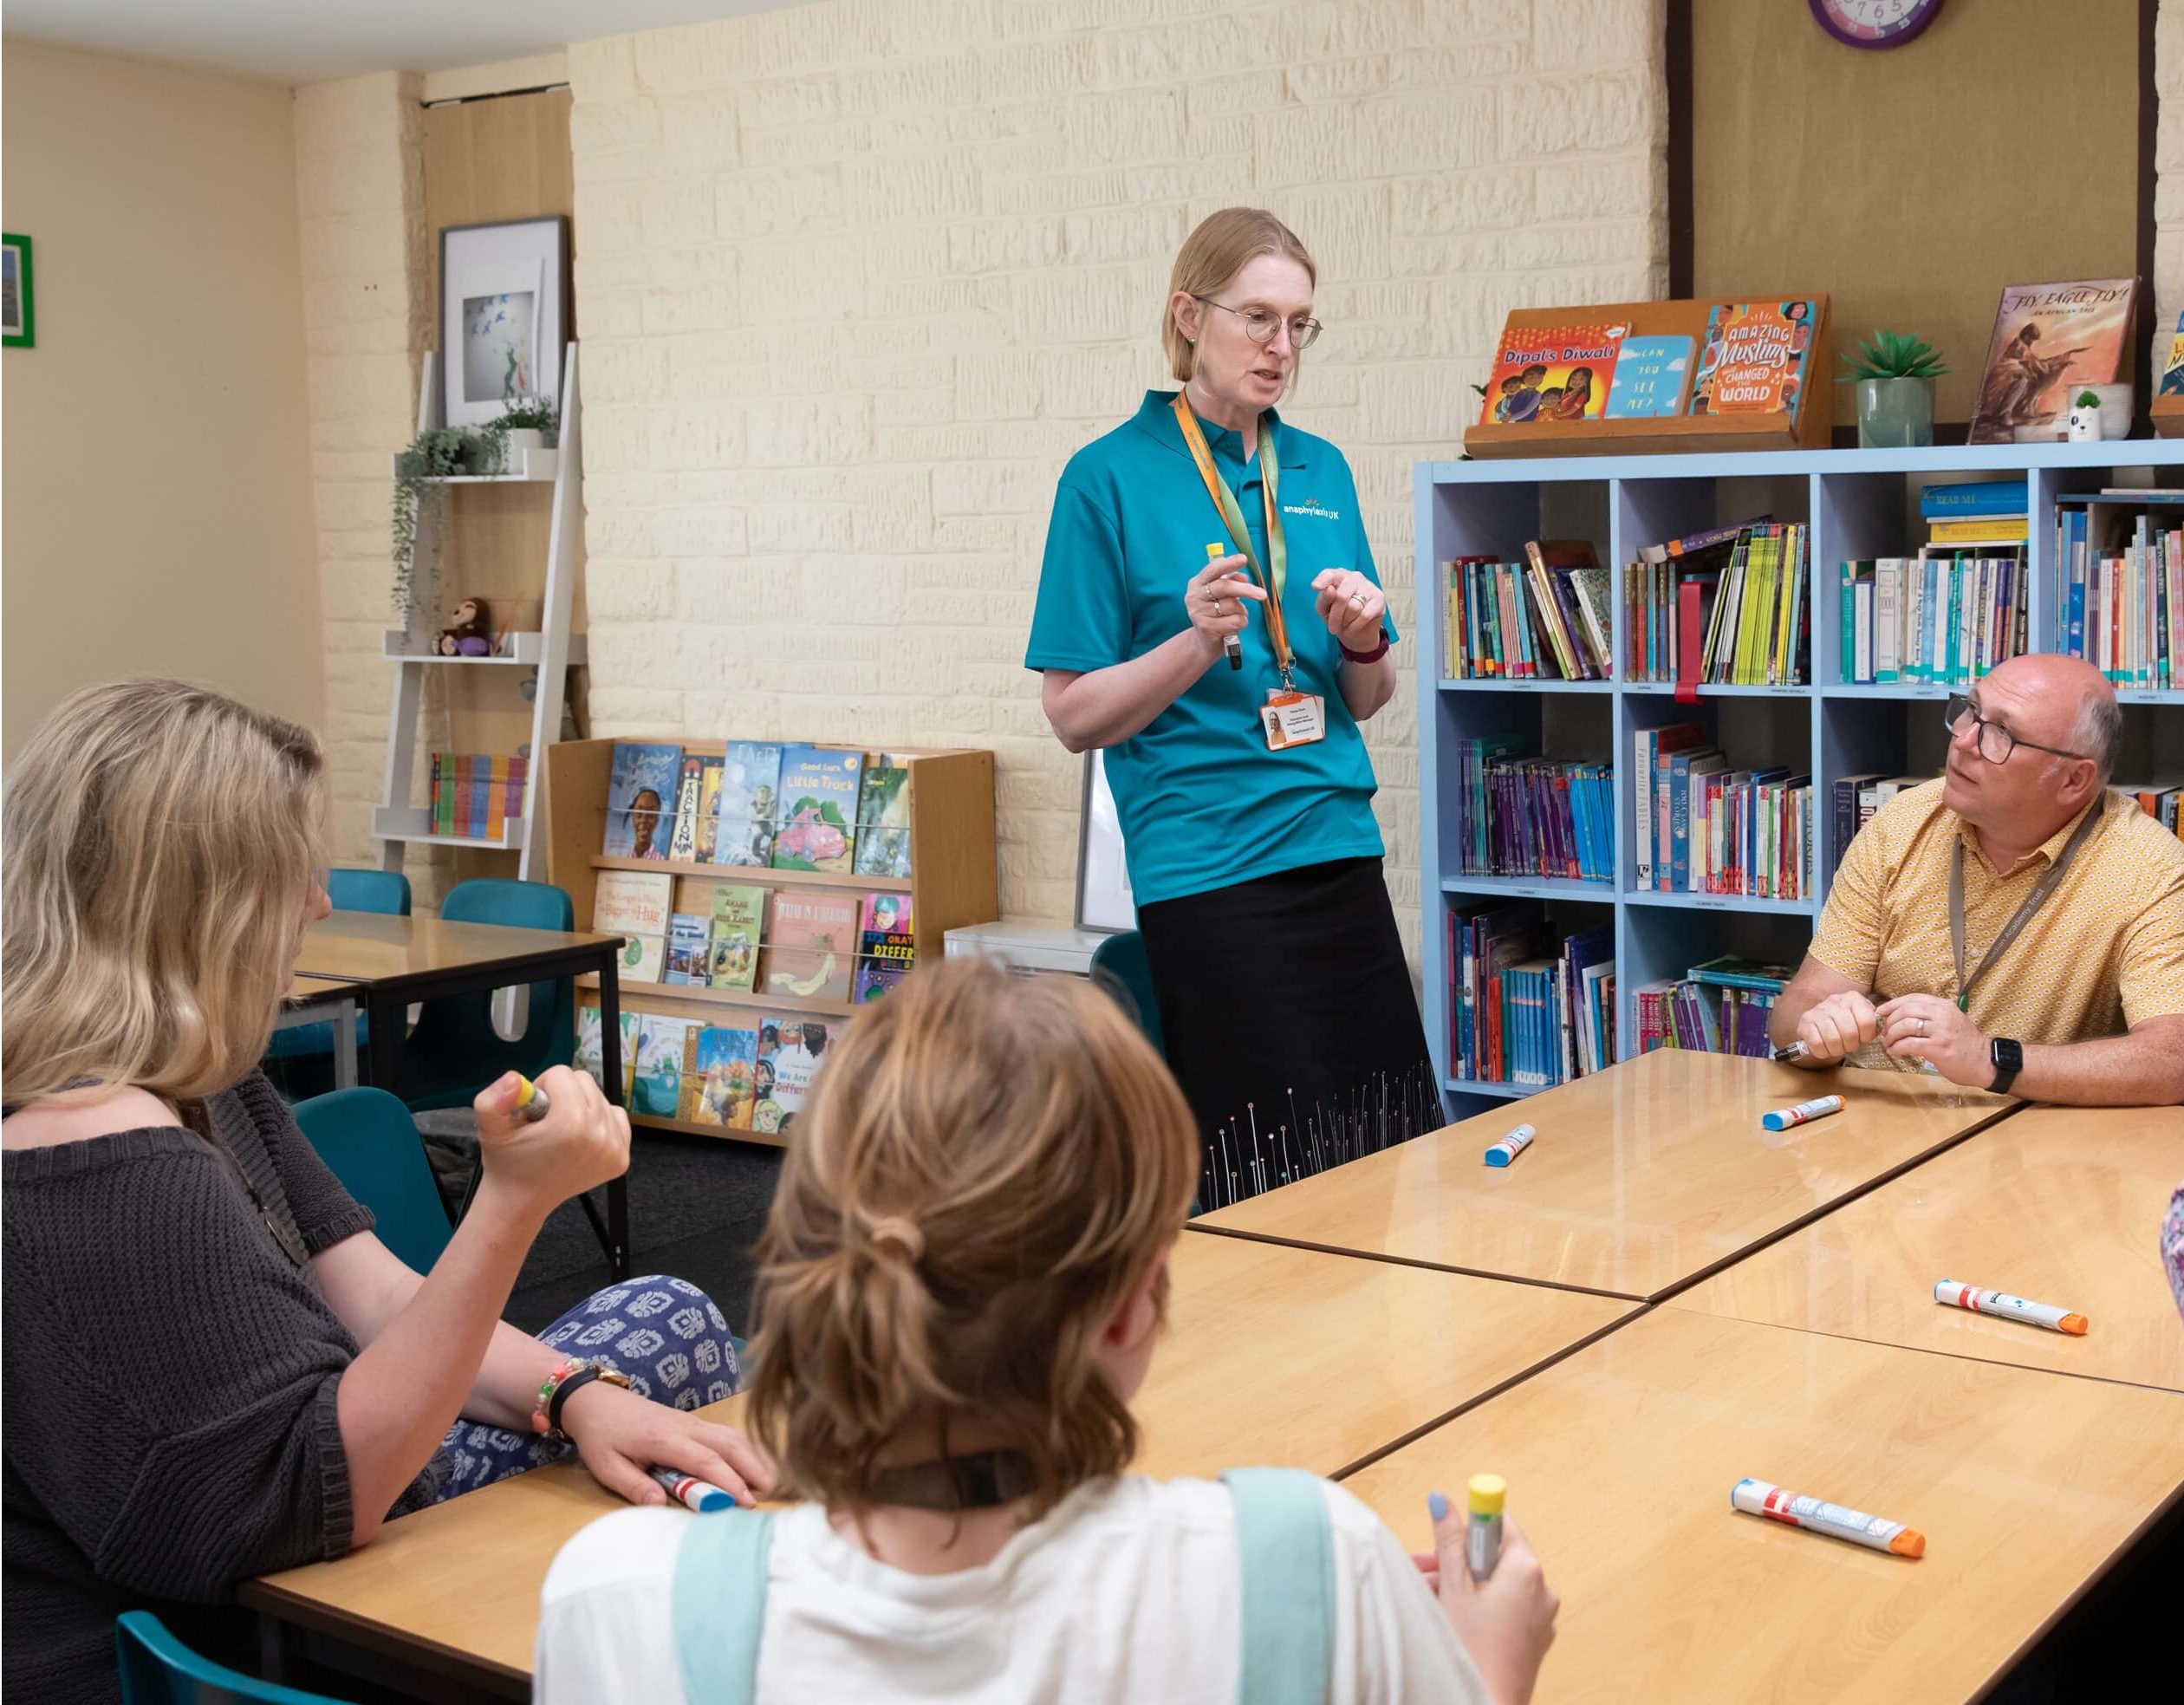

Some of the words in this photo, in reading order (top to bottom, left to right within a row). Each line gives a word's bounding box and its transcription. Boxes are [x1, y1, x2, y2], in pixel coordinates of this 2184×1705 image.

[1874, 4, 1884, 19] 6
[1505, 349, 1557, 367] Dipal's
[1563, 344, 1615, 361] Diwali
[1719, 337, 1792, 368] Muslims
[1726, 368, 1770, 384] CHANGED
[1634, 381, 1656, 393] SEE
[1720, 387, 1771, 402] WORLD
[800, 762, 822, 771] Good
[787, 775, 820, 789] Little
[822, 775, 855, 791] Truck
[2005, 907, 2031, 938] Academy
[2028, 888, 2045, 906] Trust
[887, 934, 914, 945] OKAY
[874, 944, 914, 960] DIFFER
[778, 1071, 791, 1081] We
[793, 1072, 808, 1083] Are
[776, 1081, 803, 1096] Differ
